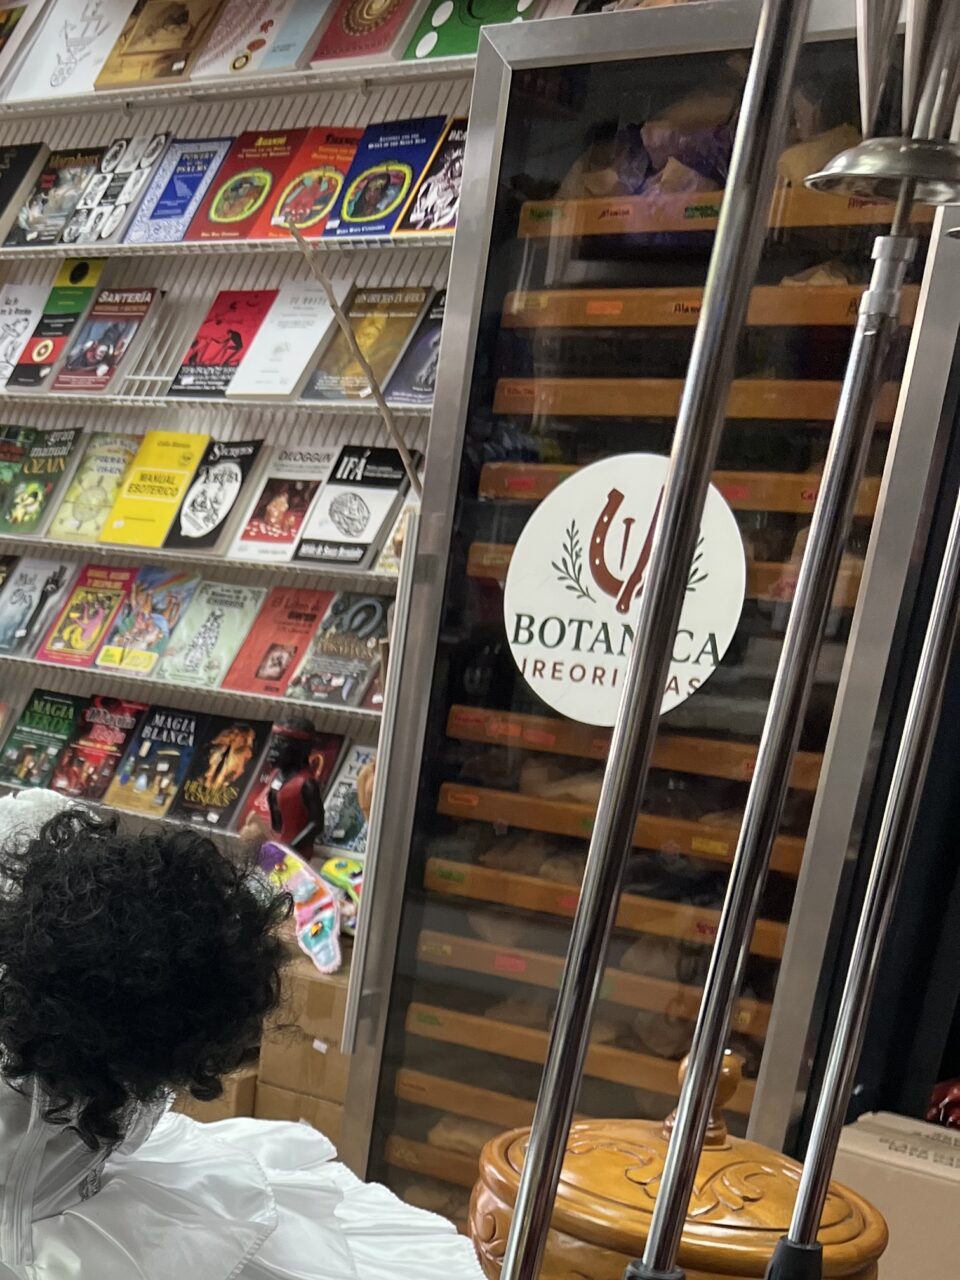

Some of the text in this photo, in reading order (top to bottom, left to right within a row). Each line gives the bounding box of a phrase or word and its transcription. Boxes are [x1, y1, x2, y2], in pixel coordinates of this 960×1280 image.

[99, 291, 152, 303] SANTERÍA
[336, 449, 371, 481] IFÁ
[140, 472, 176, 485] MANUAL
[511, 613, 721, 666] BOTANCA
[522, 658, 701, 696] IREORIAS
[33, 700, 75, 720] MAGIA
[22, 710, 70, 733] VERDE
[151, 713, 196, 733] MAGIA
[141, 725, 194, 747] BLANCA
